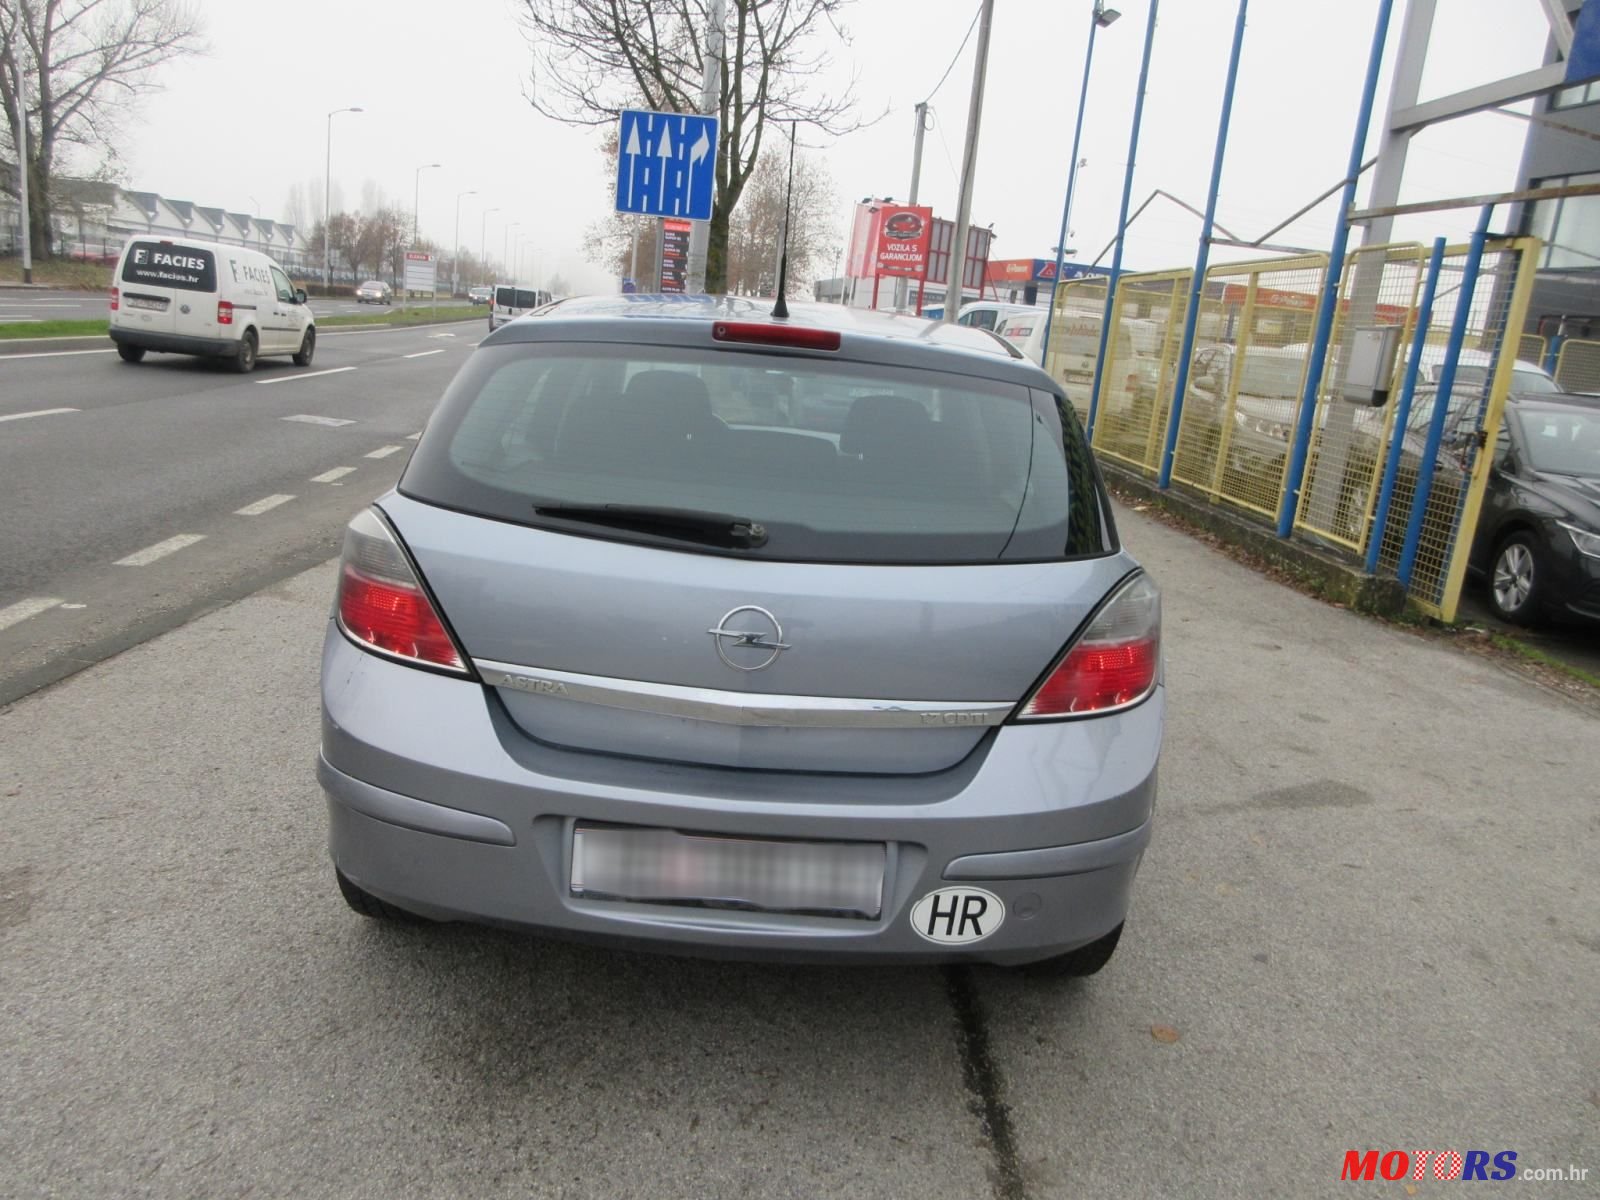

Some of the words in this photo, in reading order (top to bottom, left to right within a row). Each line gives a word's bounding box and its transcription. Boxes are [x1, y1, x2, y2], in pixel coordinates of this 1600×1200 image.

[153, 253, 205, 270] FACIES
[136, 269, 200, 284] www.facies.hr
[244, 265, 271, 285] FACIES
[503, 674, 569, 696] ASTRA
[942, 712, 989, 725] CDTI
[927, 894, 988, 936] HR
